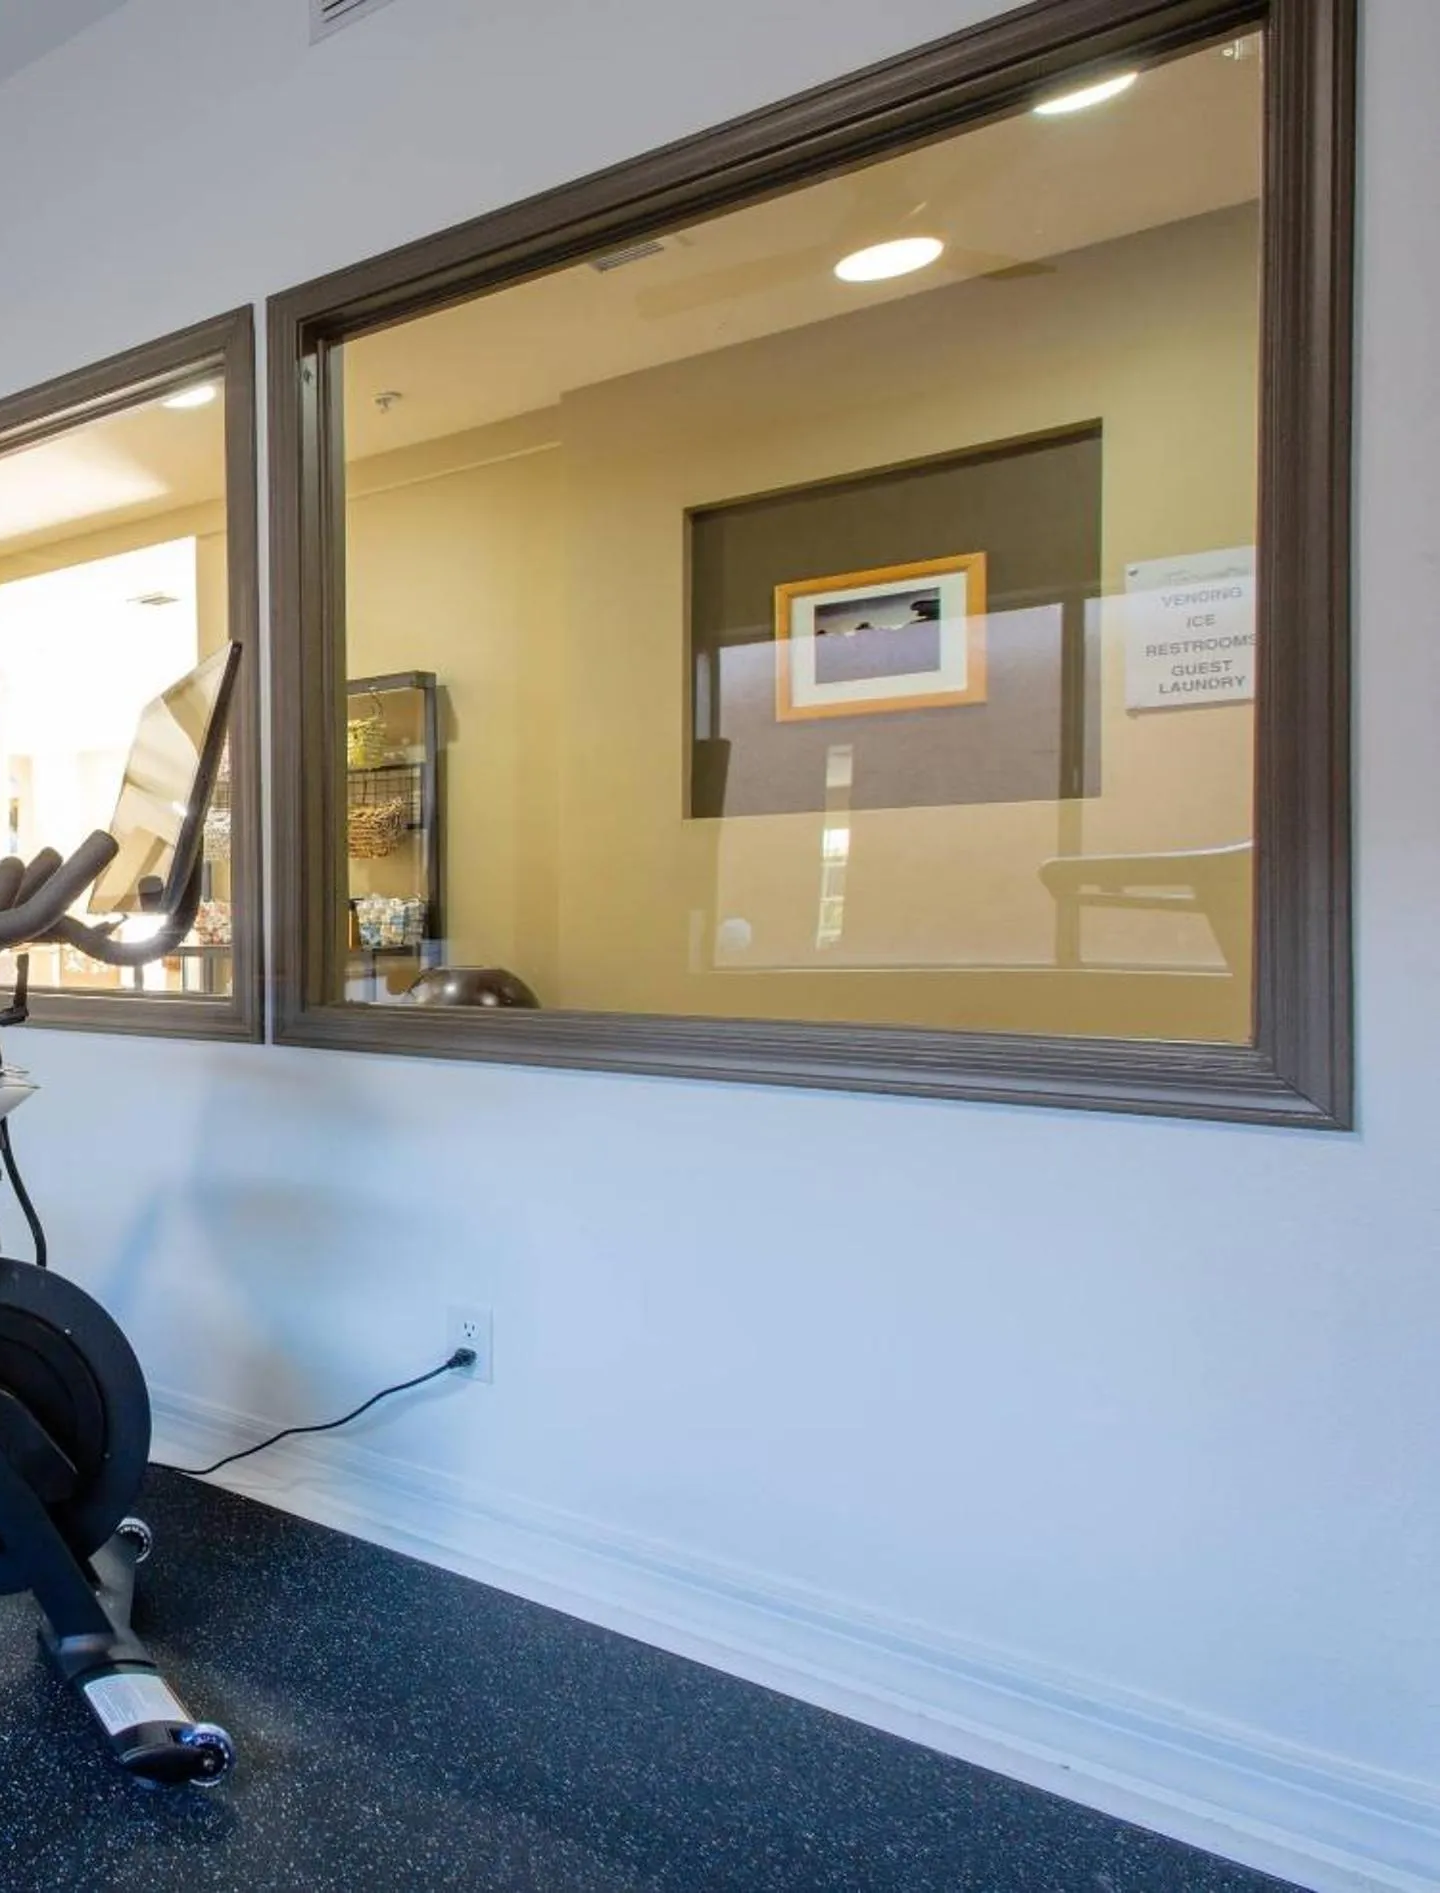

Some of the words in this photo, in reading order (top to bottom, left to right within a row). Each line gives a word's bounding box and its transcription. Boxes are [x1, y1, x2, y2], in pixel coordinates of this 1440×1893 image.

[1161, 586, 1242, 608] VENDING
[1186, 613, 1216, 628] ICE
[1171, 659, 1233, 677] GUEST
[1158, 675, 1246, 694] LAUNDRY
